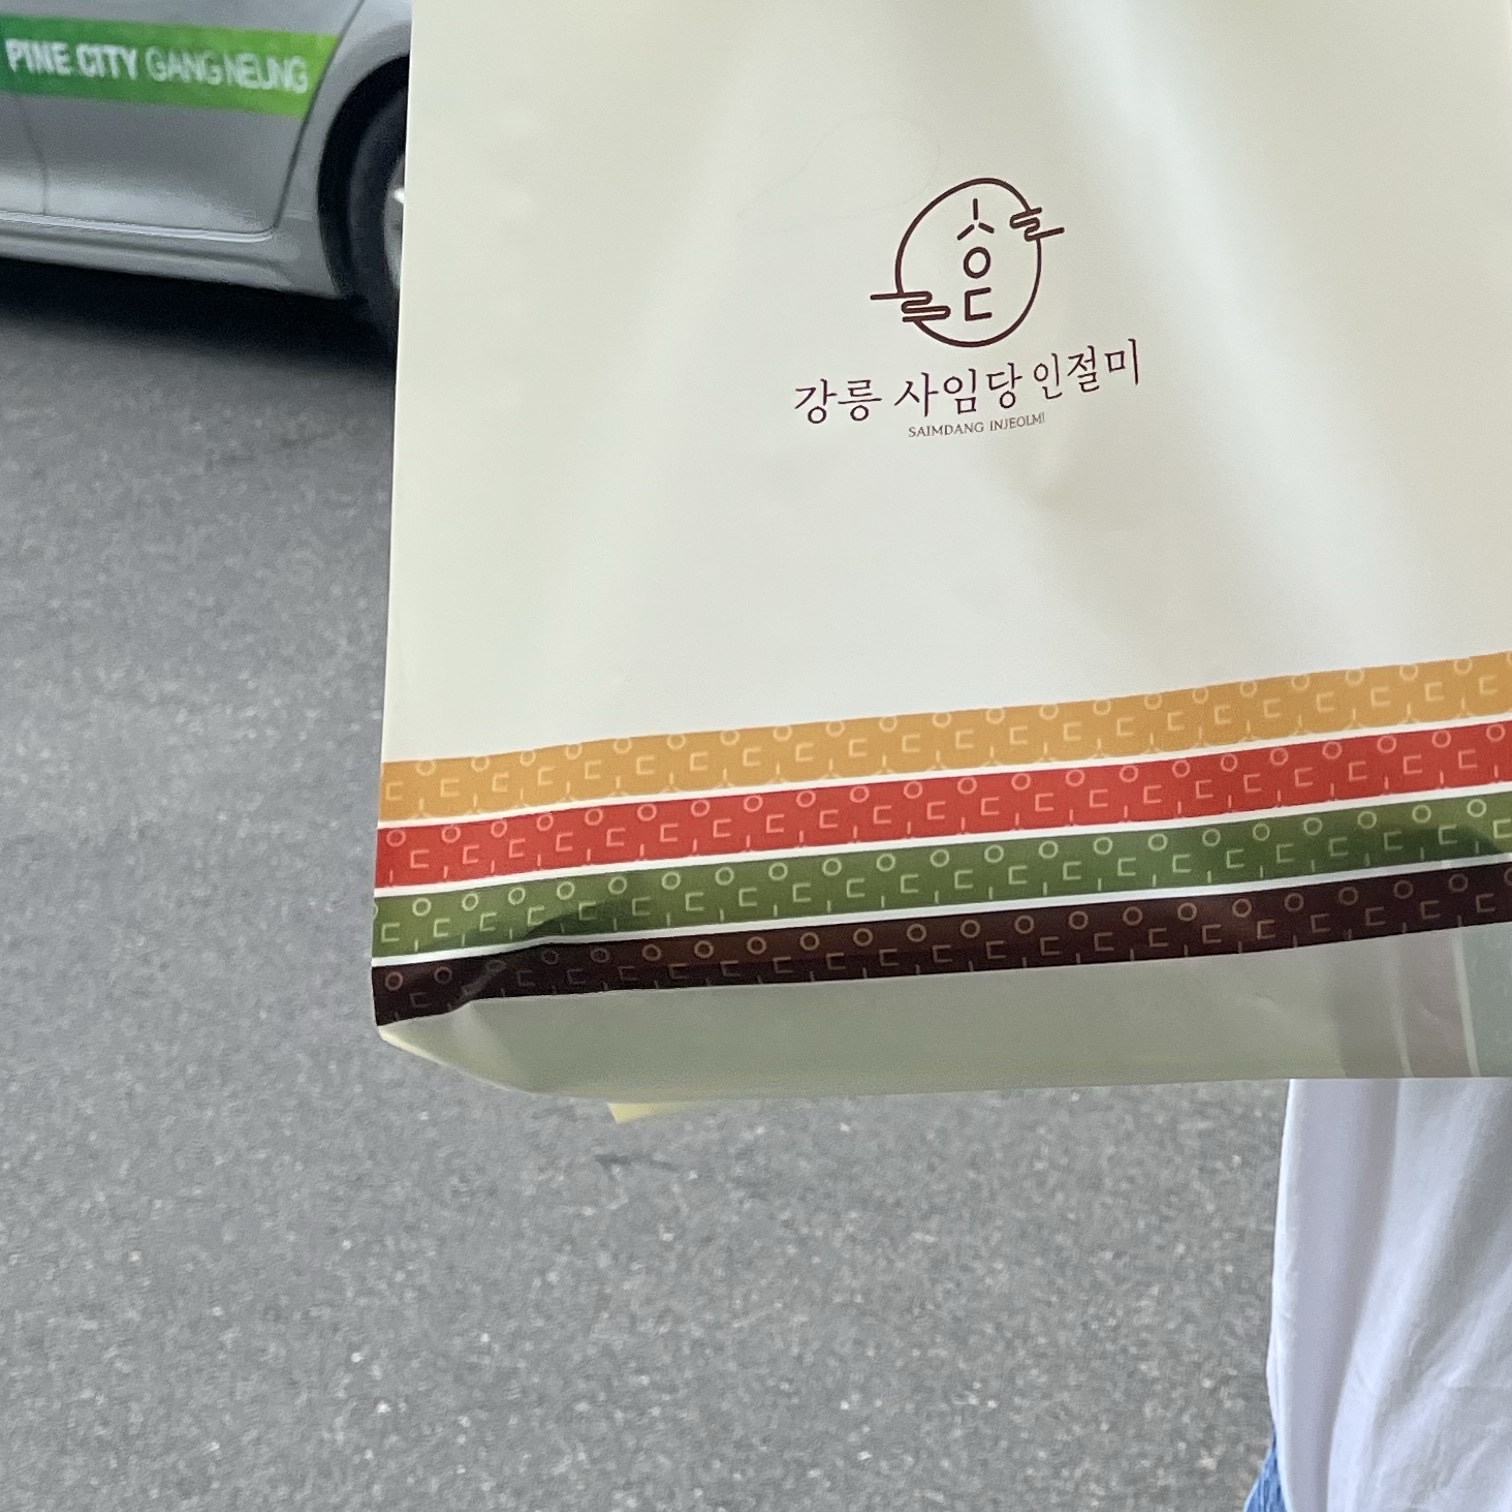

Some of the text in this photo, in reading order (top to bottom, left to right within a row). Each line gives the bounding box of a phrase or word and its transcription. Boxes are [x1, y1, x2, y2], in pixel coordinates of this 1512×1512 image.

[5, 39, 72, 76] PINE
[76, 43, 137, 81] CITY
[795, 338, 1140, 425] 강릉 사임당 인절미
[908, 411, 1046, 438] SAIMDANG INJEOLMI
